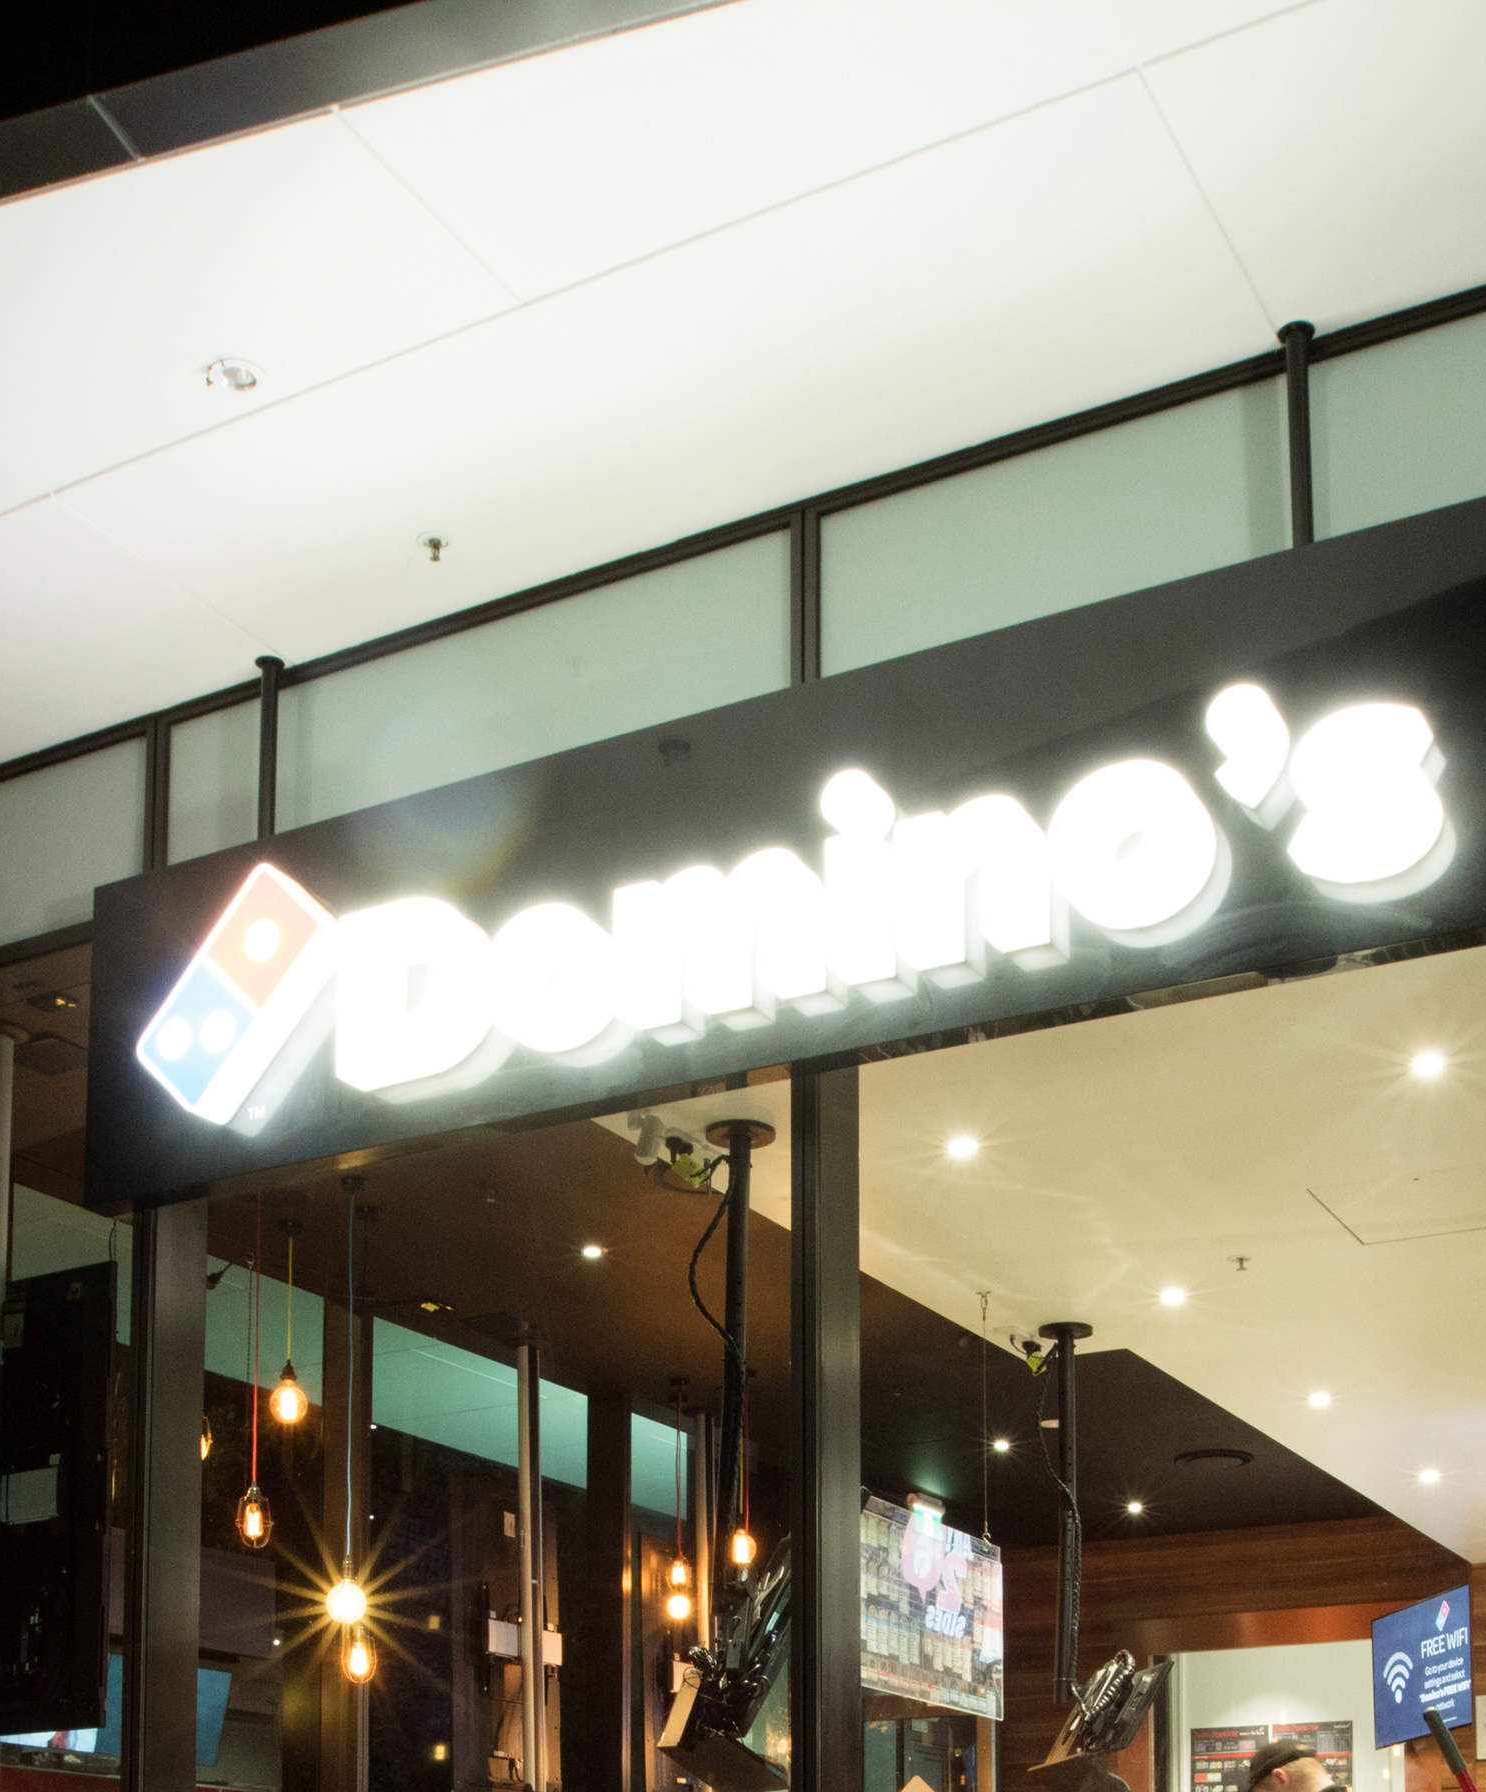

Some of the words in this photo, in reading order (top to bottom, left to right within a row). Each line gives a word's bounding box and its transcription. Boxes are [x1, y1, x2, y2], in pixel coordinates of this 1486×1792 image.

[335, 680, 1453, 1094] Domino's
[1421, 1634, 1446, 1659] FREE
[1446, 1627, 1468, 1650] WIFI
[1448, 1657, 1464, 1670] device
